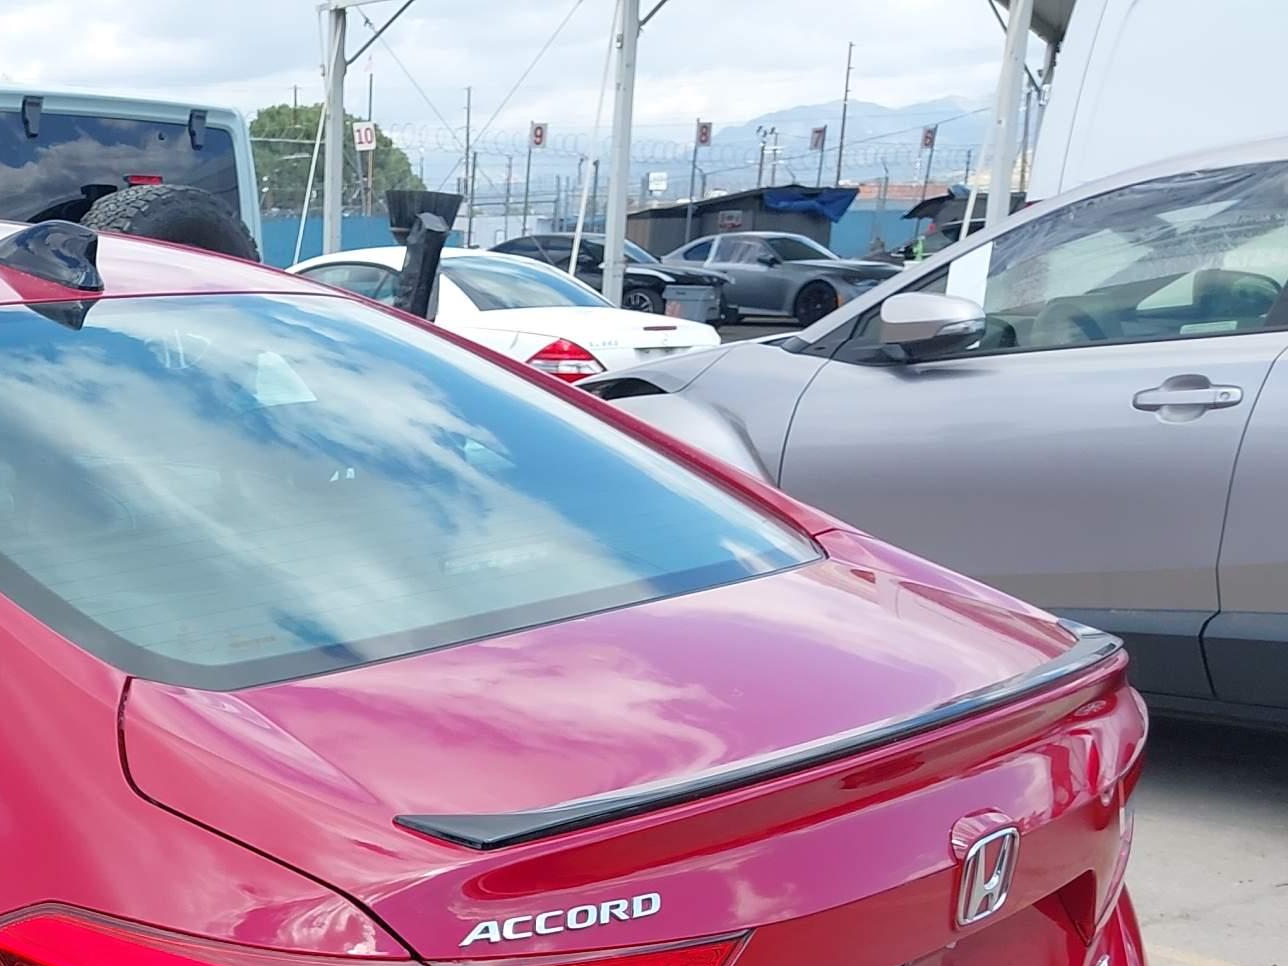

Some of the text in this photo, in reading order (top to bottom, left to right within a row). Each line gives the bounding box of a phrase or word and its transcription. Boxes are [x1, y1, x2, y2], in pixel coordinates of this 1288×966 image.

[356, 127, 374, 144] 10
[534, 126, 543, 145] 9
[699, 125, 708, 144] 8
[458, 892, 662, 948] ACCORD
